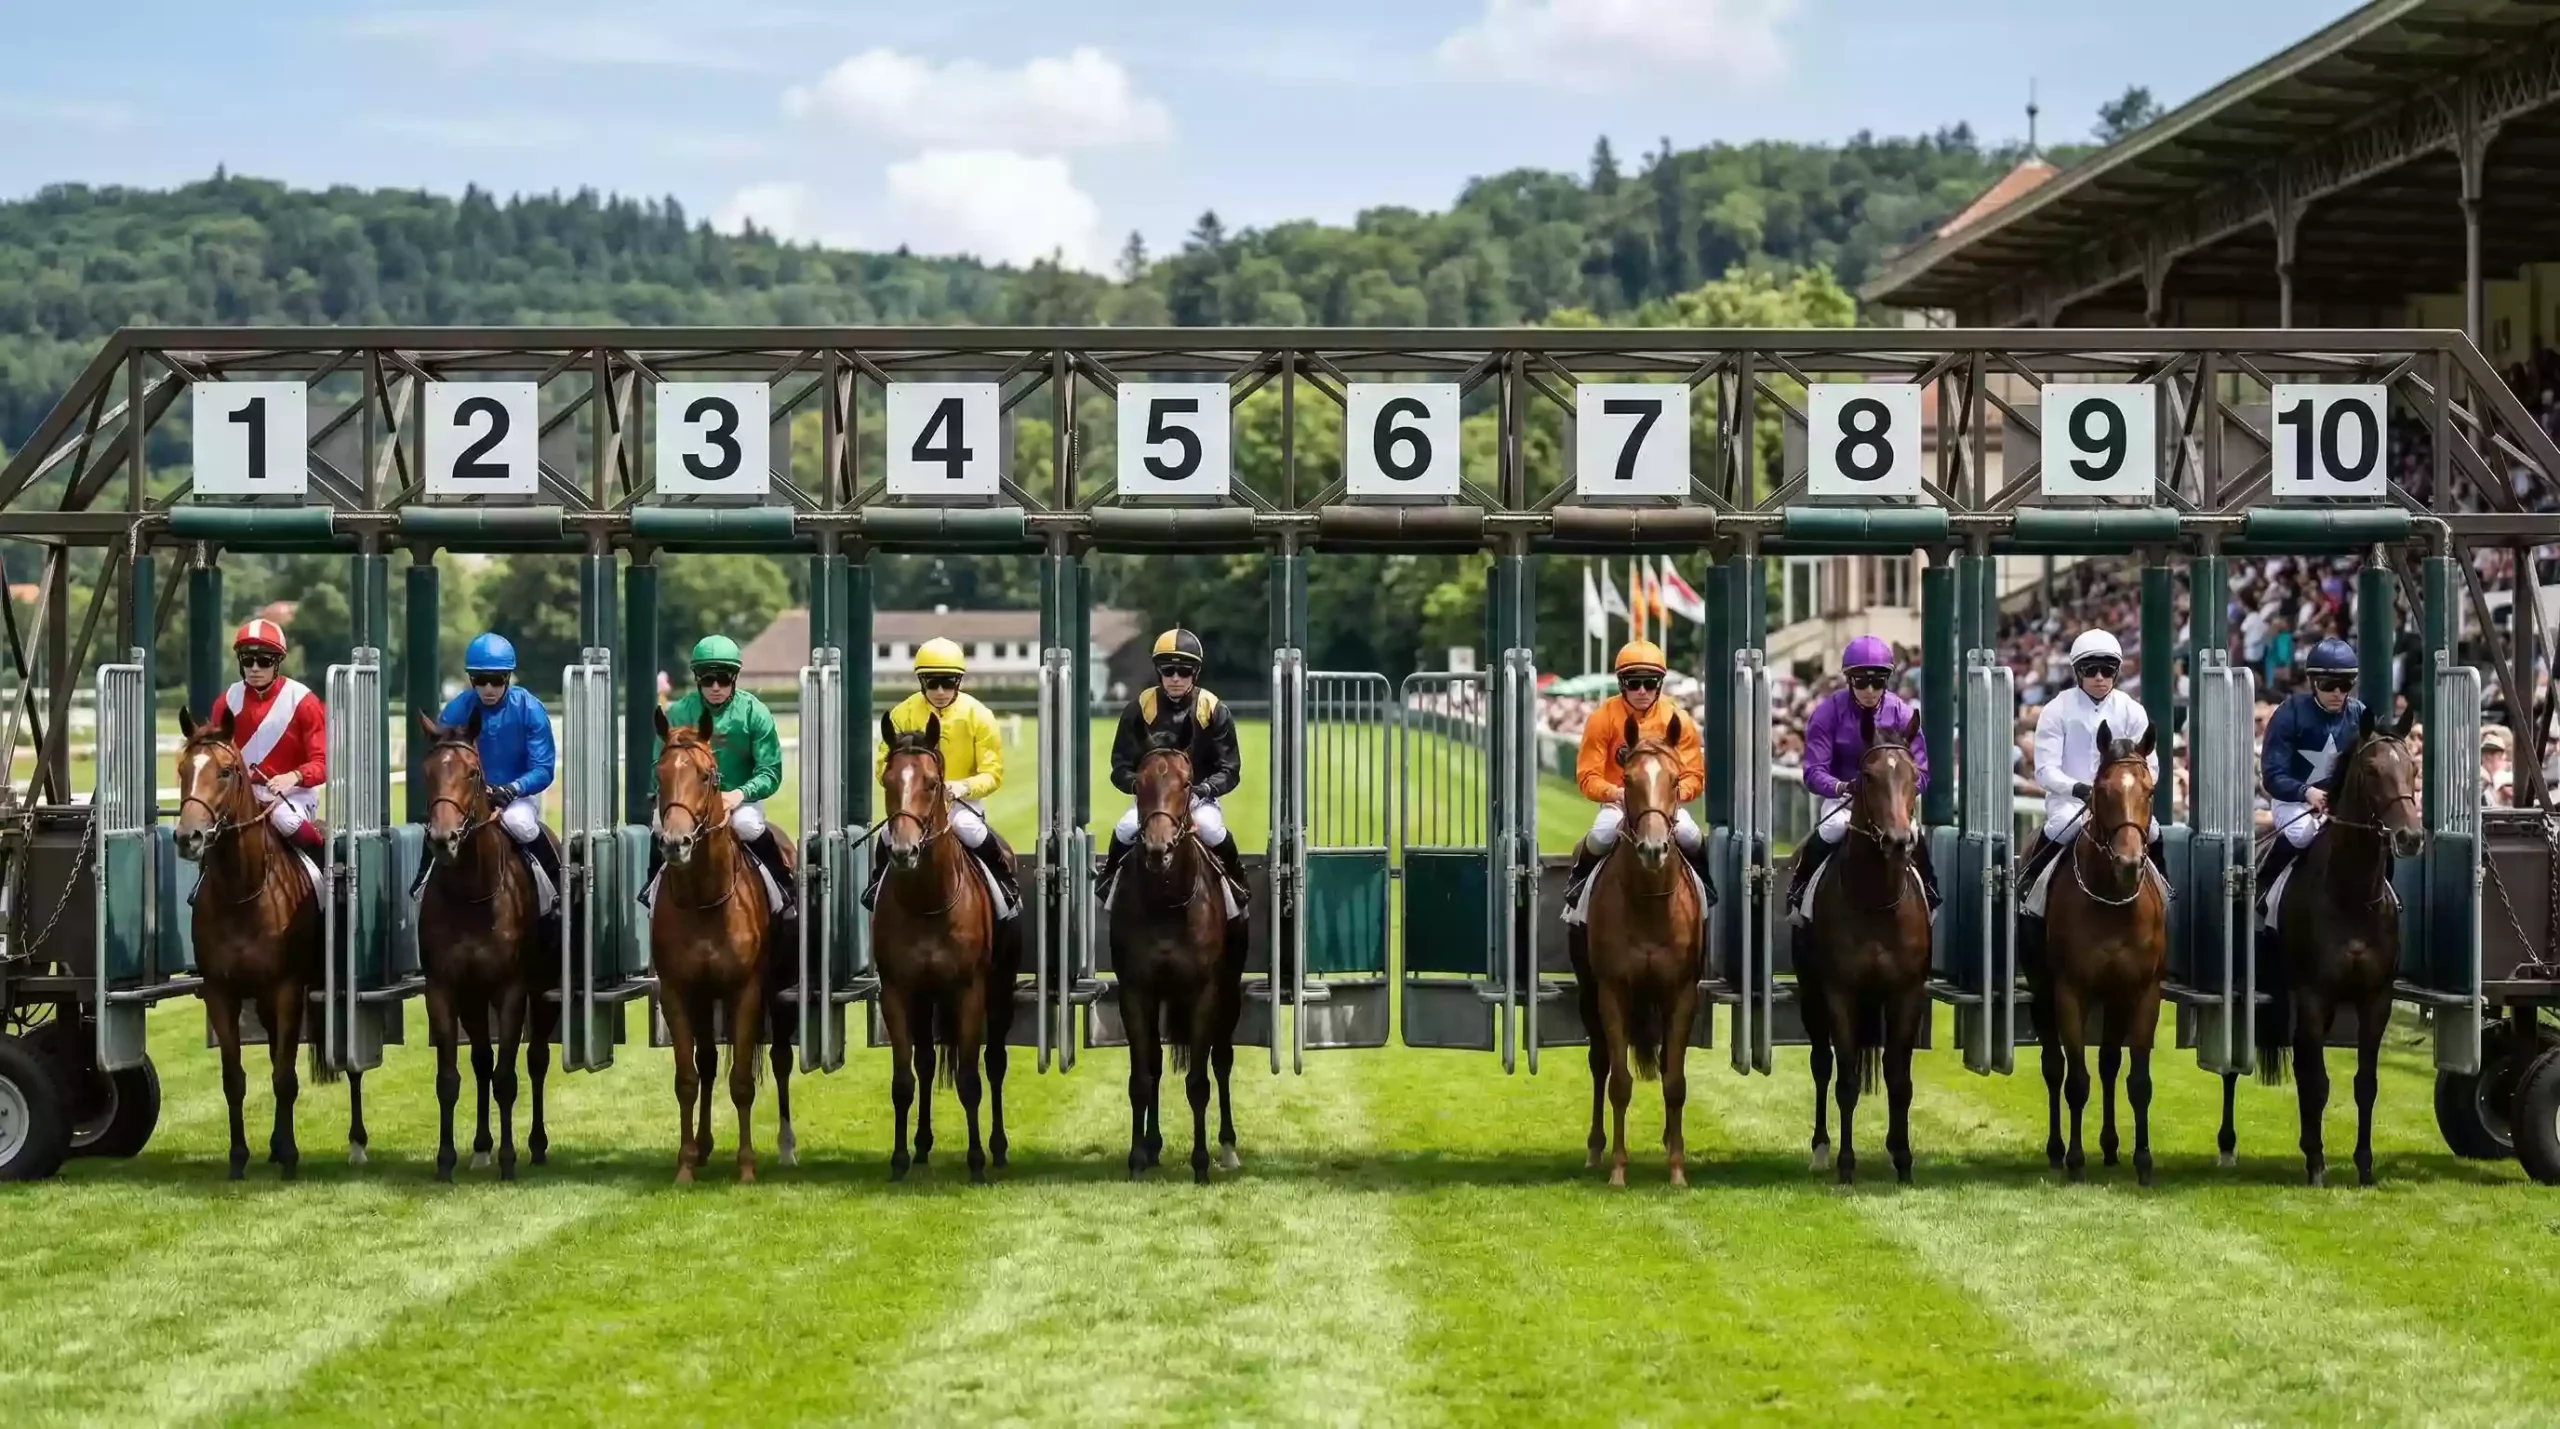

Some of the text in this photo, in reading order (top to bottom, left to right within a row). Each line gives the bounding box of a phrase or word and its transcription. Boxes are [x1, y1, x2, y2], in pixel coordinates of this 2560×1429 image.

[228, 397, 266, 479] 1
[451, 396, 510, 479] 2
[682, 396, 742, 481] 3
[911, 397, 973, 479] 4
[1143, 398, 1202, 481] 5
[1373, 397, 1432, 481] 6
[1603, 399, 1663, 480] 7
[1835, 398, 1894, 482] 8
[2068, 397, 2127, 482] 9
[2279, 398, 2377, 483] 10
